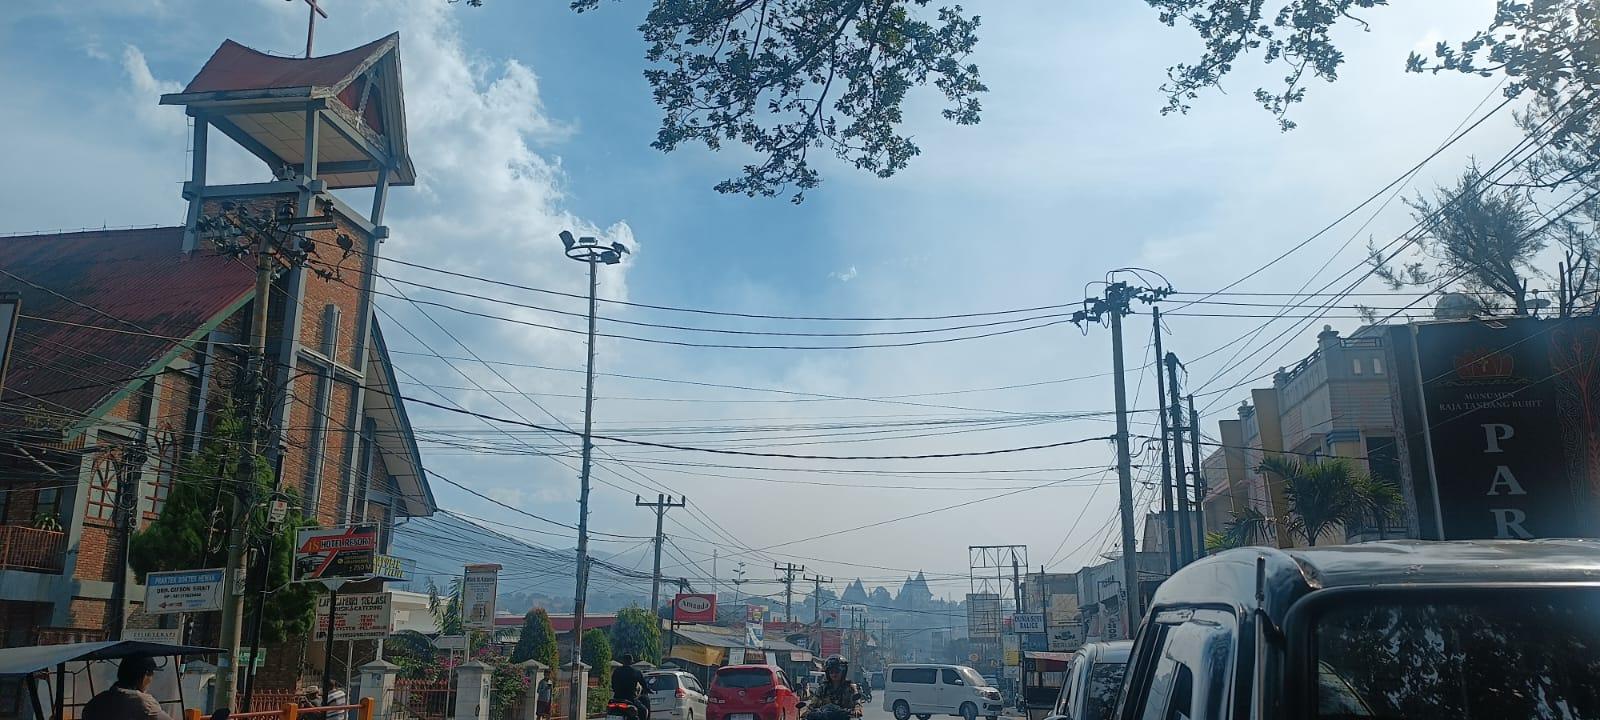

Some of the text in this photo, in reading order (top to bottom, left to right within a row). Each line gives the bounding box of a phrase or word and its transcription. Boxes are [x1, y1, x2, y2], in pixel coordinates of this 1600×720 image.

[1464, 391, 1515, 401] MONUMEN
[1439, 402, 1462, 411] RAJA
[1463, 401, 1510, 410] TANDANG
[321, 539, 343, 549] HOTEL
[344, 537, 372, 547] RESORT
[681, 600, 709, 610] Amanda
